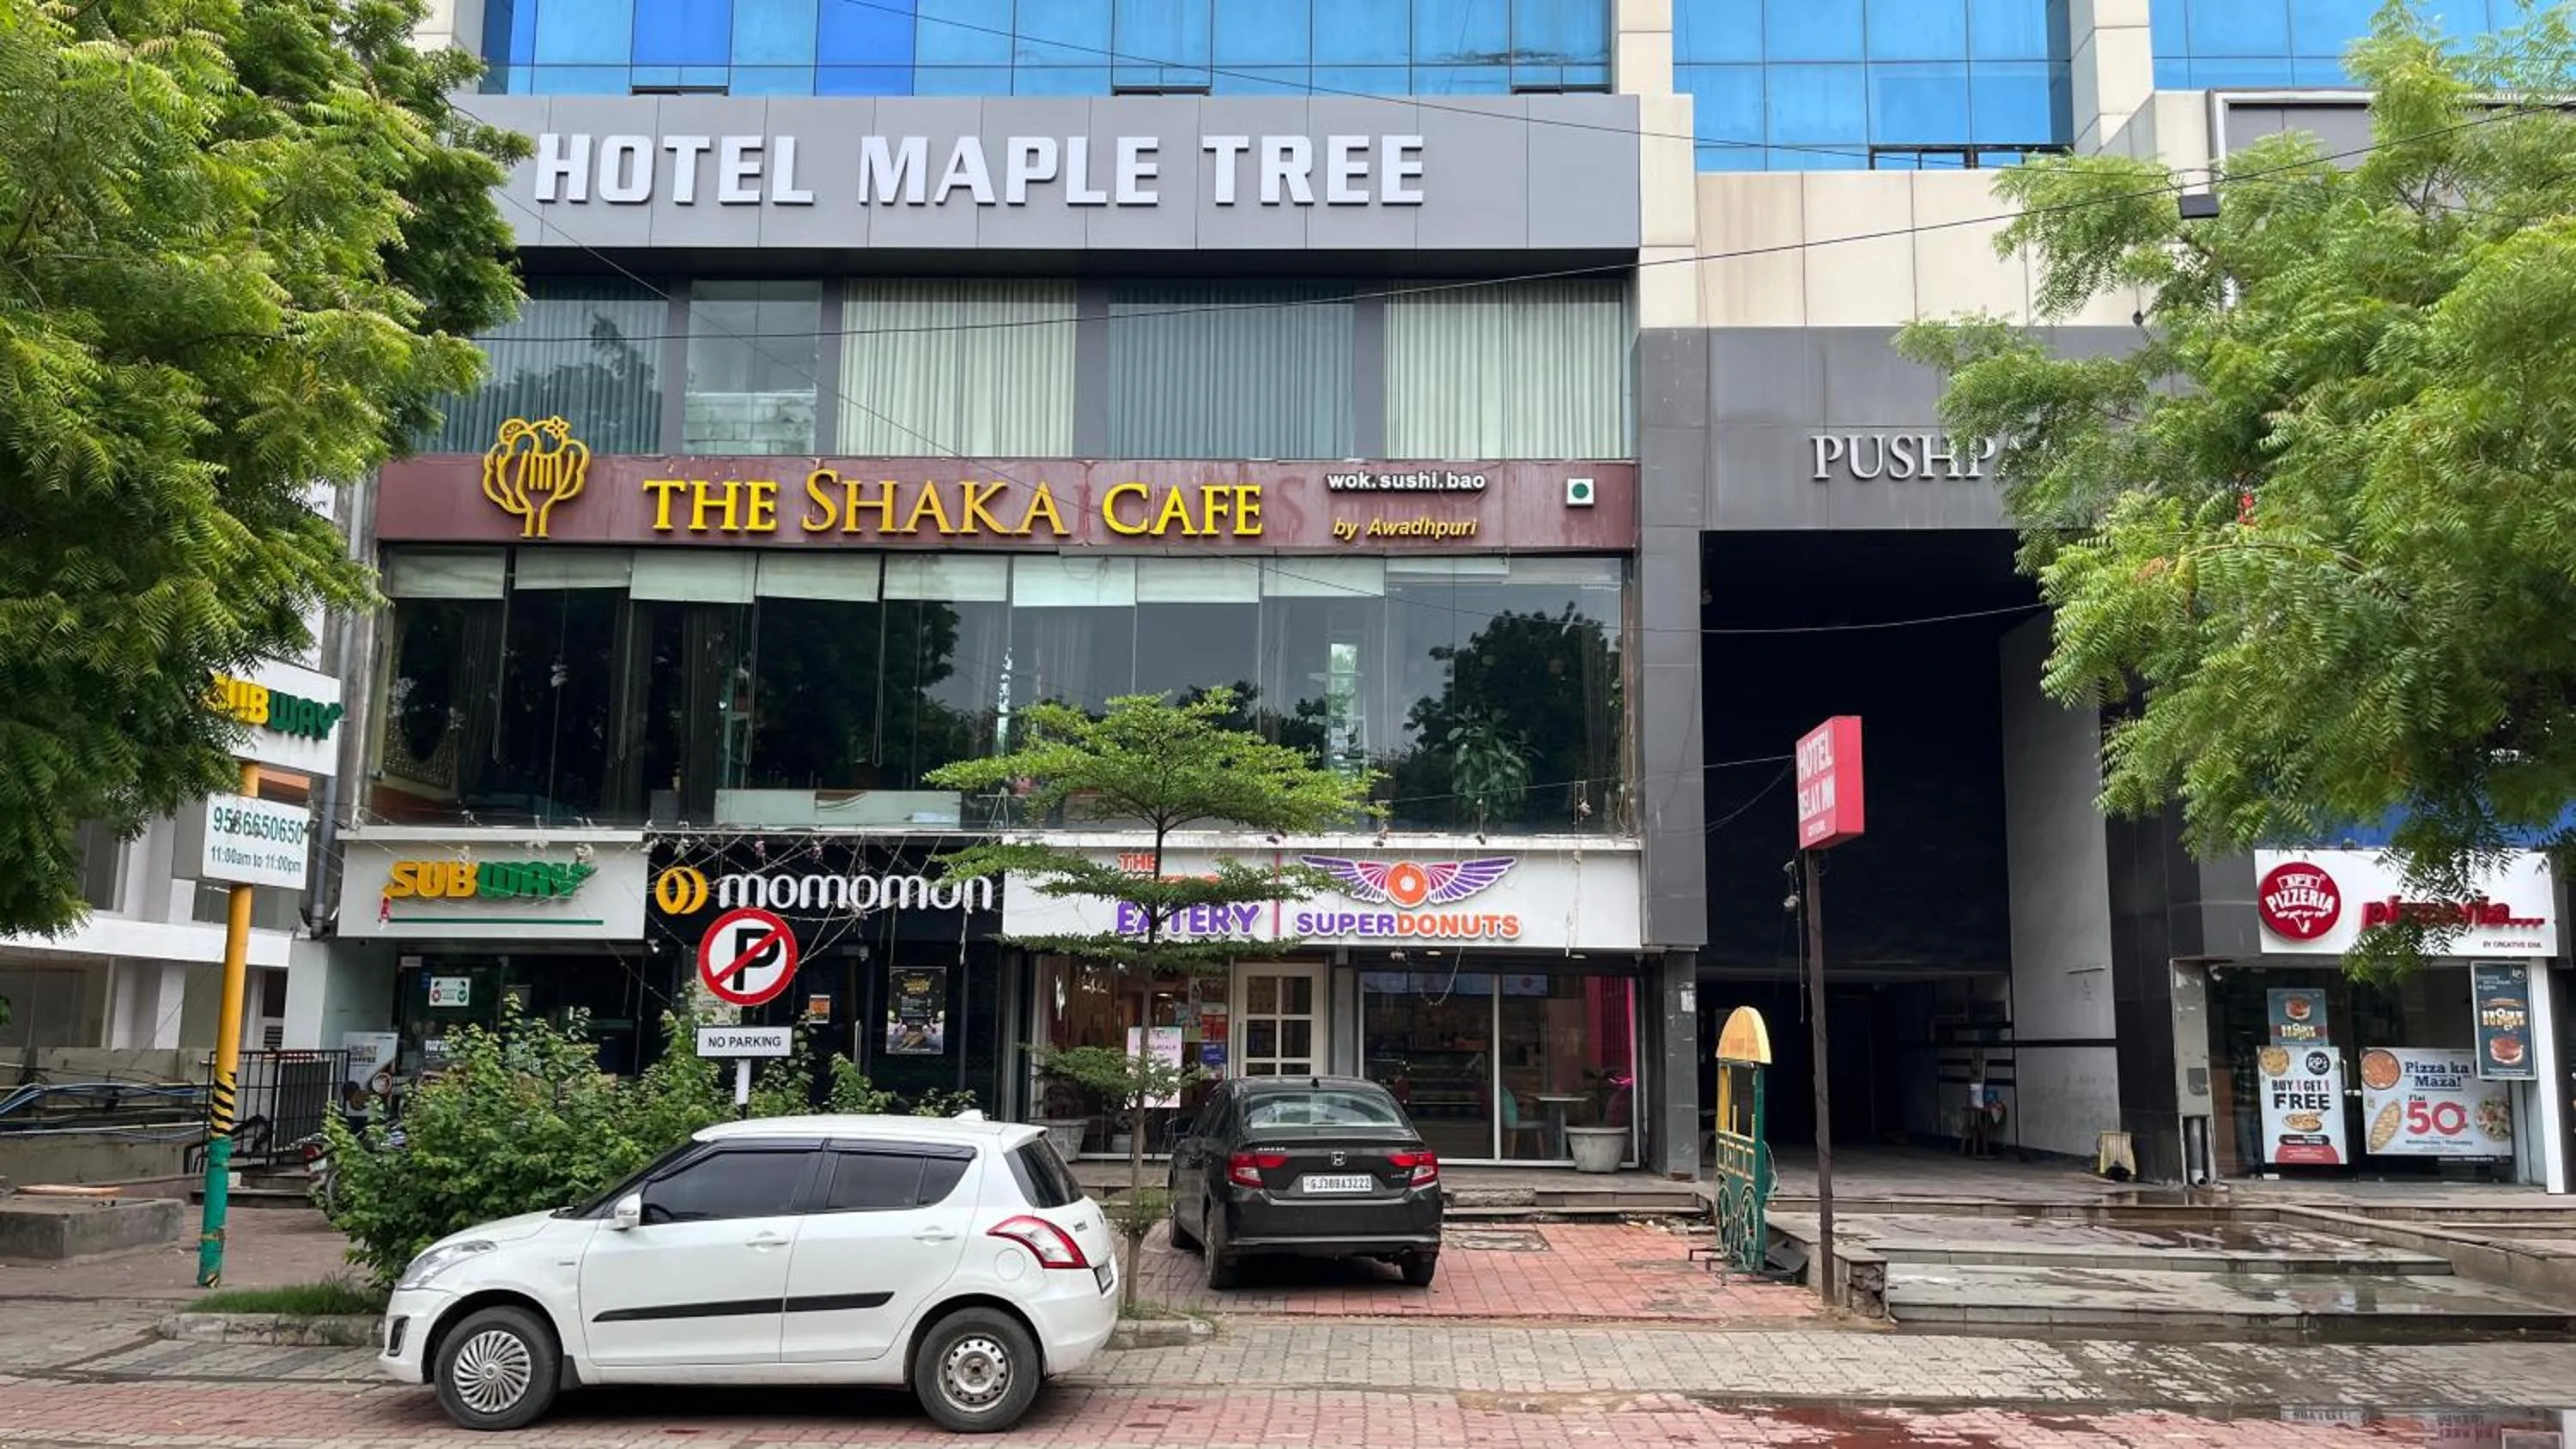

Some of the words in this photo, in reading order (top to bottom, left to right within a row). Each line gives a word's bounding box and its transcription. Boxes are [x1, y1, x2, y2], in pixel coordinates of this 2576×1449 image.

[535, 133, 814, 205] HOTEL
[859, 135, 1159, 205] MAPLE
[1202, 135, 1425, 205] TREE
[1810, 433, 2018, 480] PUSHP
[1327, 471, 1486, 492] wok.sushi.bao
[643, 479, 779, 532] THE
[801, 468, 1071, 536] SHAKA
[1102, 482, 1264, 537] CAFE
[1333, 518, 1358, 542] by
[1367, 517, 1479, 541] Awadhpuri
[1798, 729, 1834, 784] HOTEL
[211, 846, 252, 866] 11:00am
[253, 852, 262, 867] to
[265, 852, 301, 874] 11:00pm
[1119, 852, 1157, 872] THE
[384, 861, 598, 899] SUBWAY
[2264, 888, 2336, 913] PIZZERIA
[1296, 911, 1522, 937] SUPERDONUTS
[732, 928, 781, 991] P
[708, 1036, 726, 1048] NO
[729, 1035, 782, 1048] PARKING
[2404, 1061, 2446, 1074] Pizza
[2450, 1061, 2470, 1074] ka
[2271, 1079, 2293, 1092] BUY
[2303, 1079, 2322, 1092] GET
[2414, 1075, 2463, 1088] Maza!
[2273, 1093, 2331, 1111] FREE
[2406, 1100, 2466, 1136] 50
